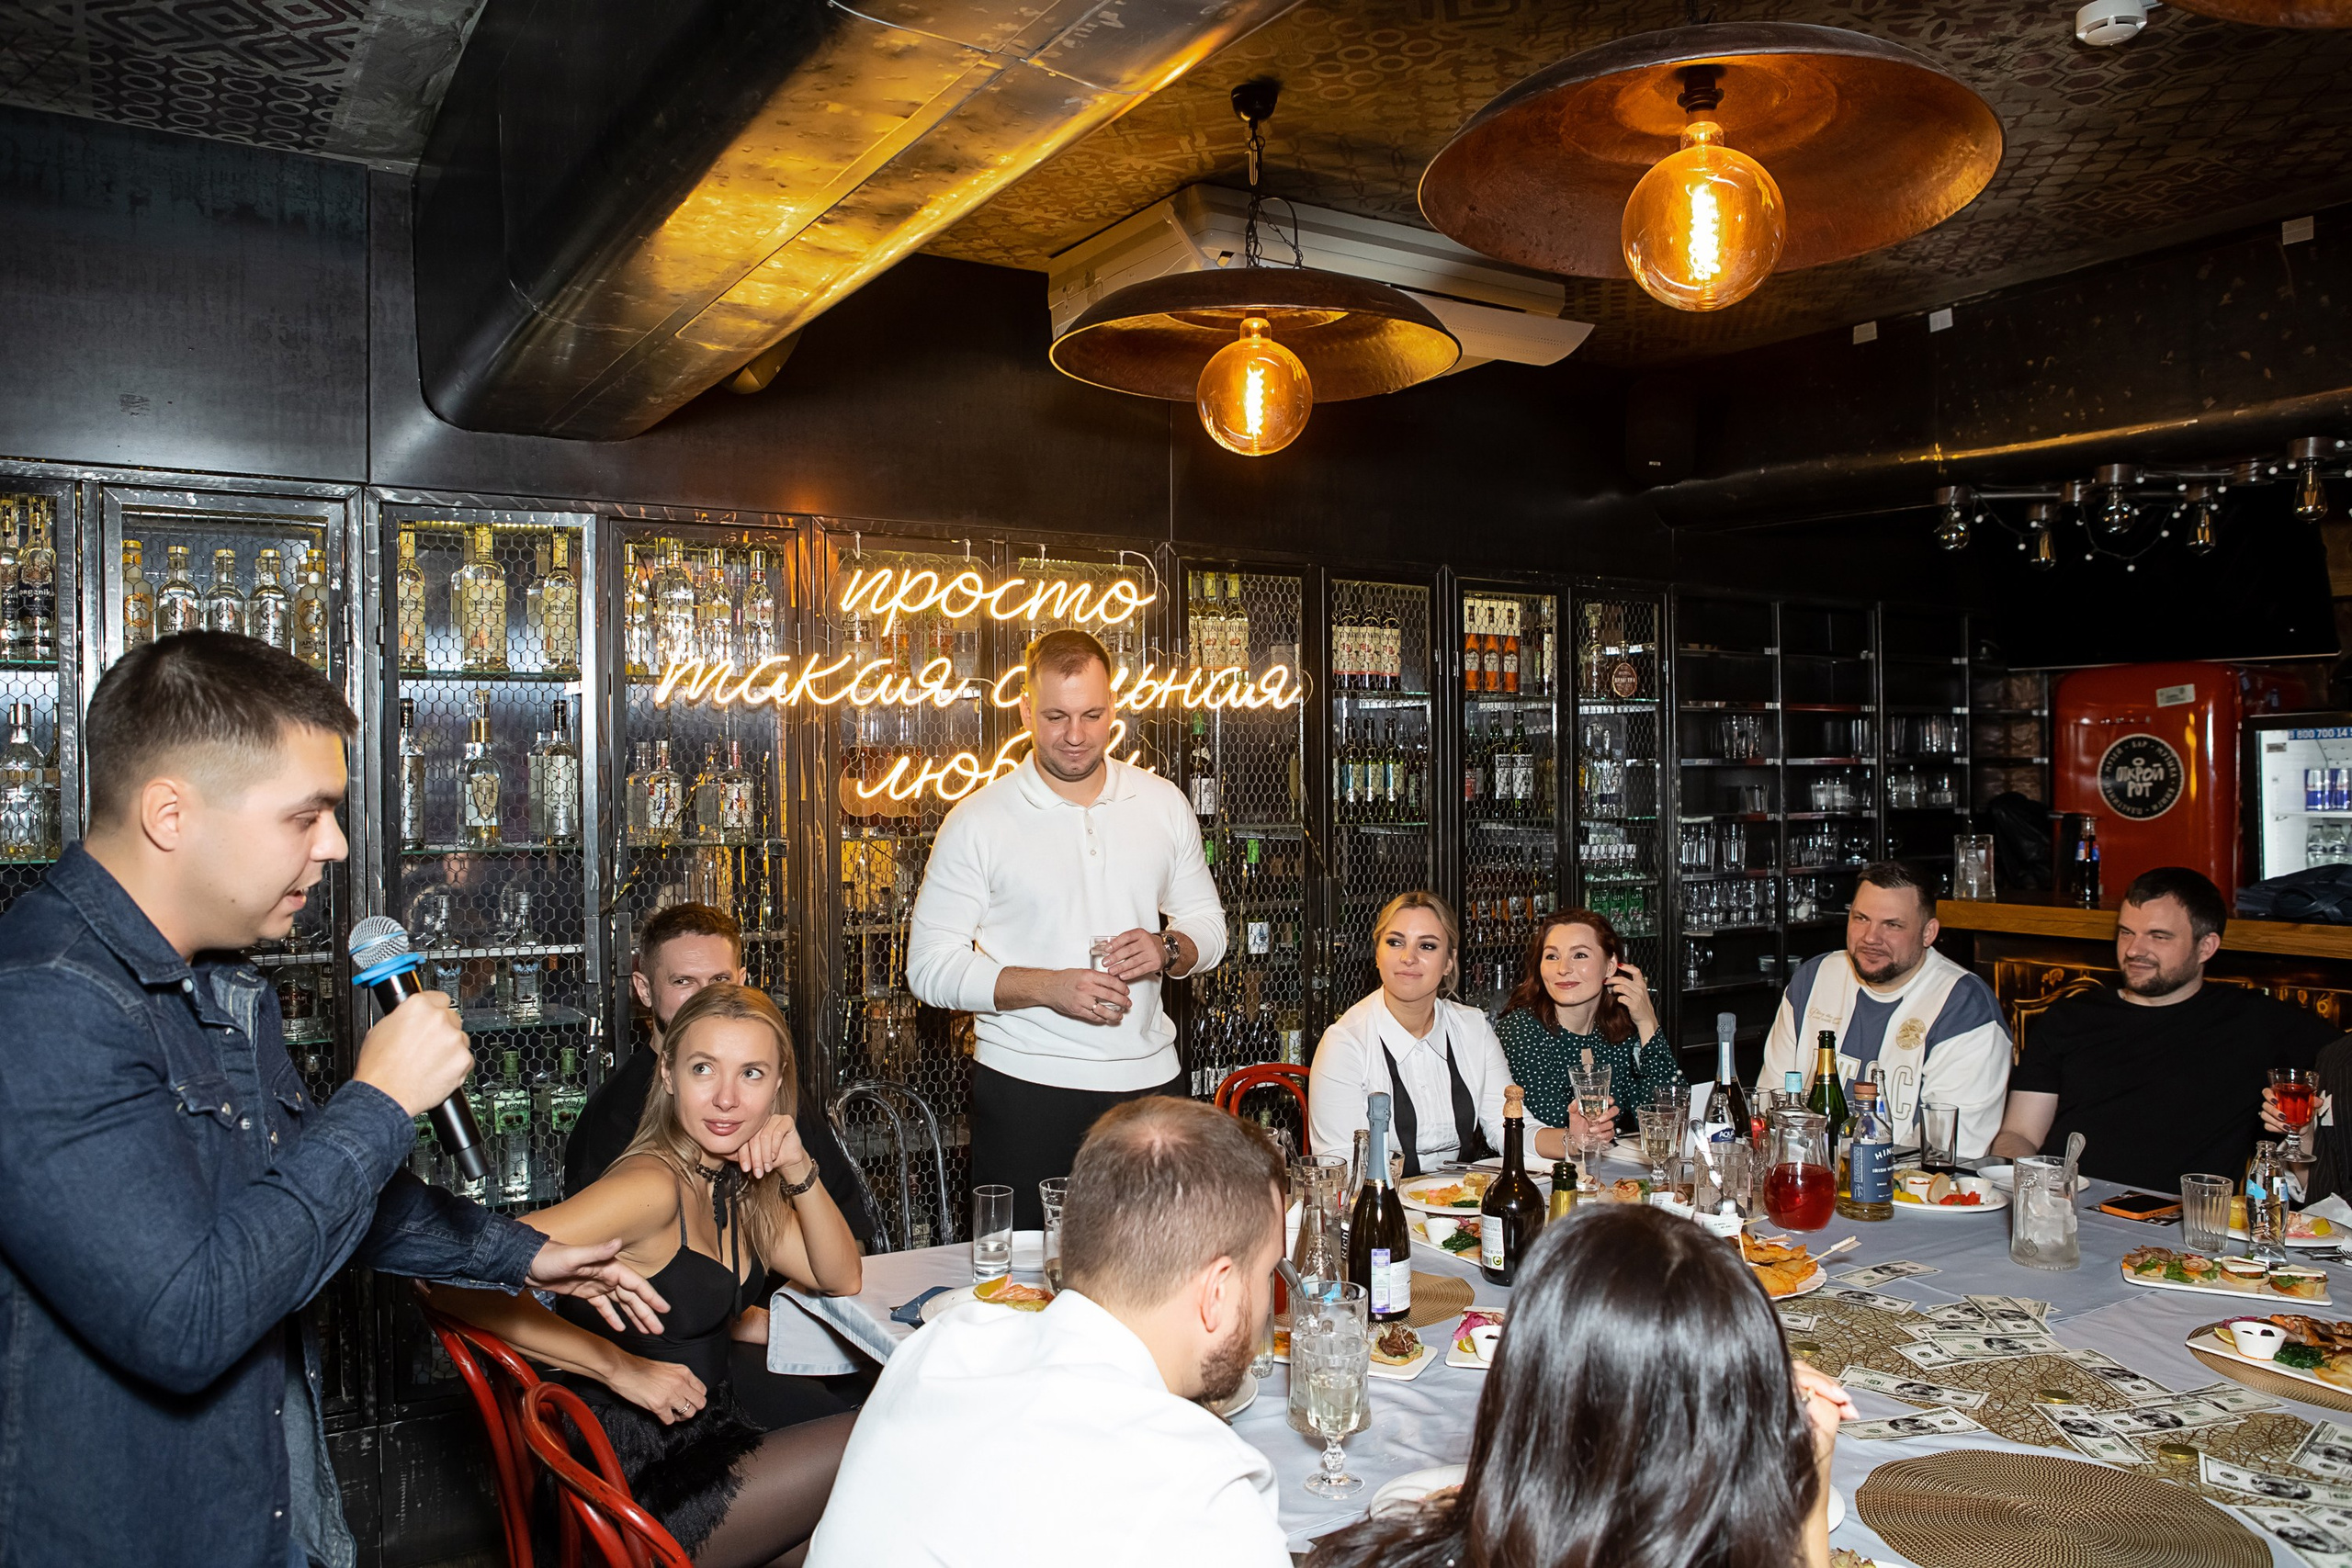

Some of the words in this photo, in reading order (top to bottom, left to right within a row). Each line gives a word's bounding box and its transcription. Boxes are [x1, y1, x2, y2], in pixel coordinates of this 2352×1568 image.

[840, 568, 1157, 637] просто
[655, 653, 970, 708] такая
[992, 662, 1303, 711] сьная
[856, 718, 1157, 801] люб
[2317, 729, 2335, 738] 700
[2336, 728, 2348, 738] 14
[2127, 781, 2154, 798] РОТ
